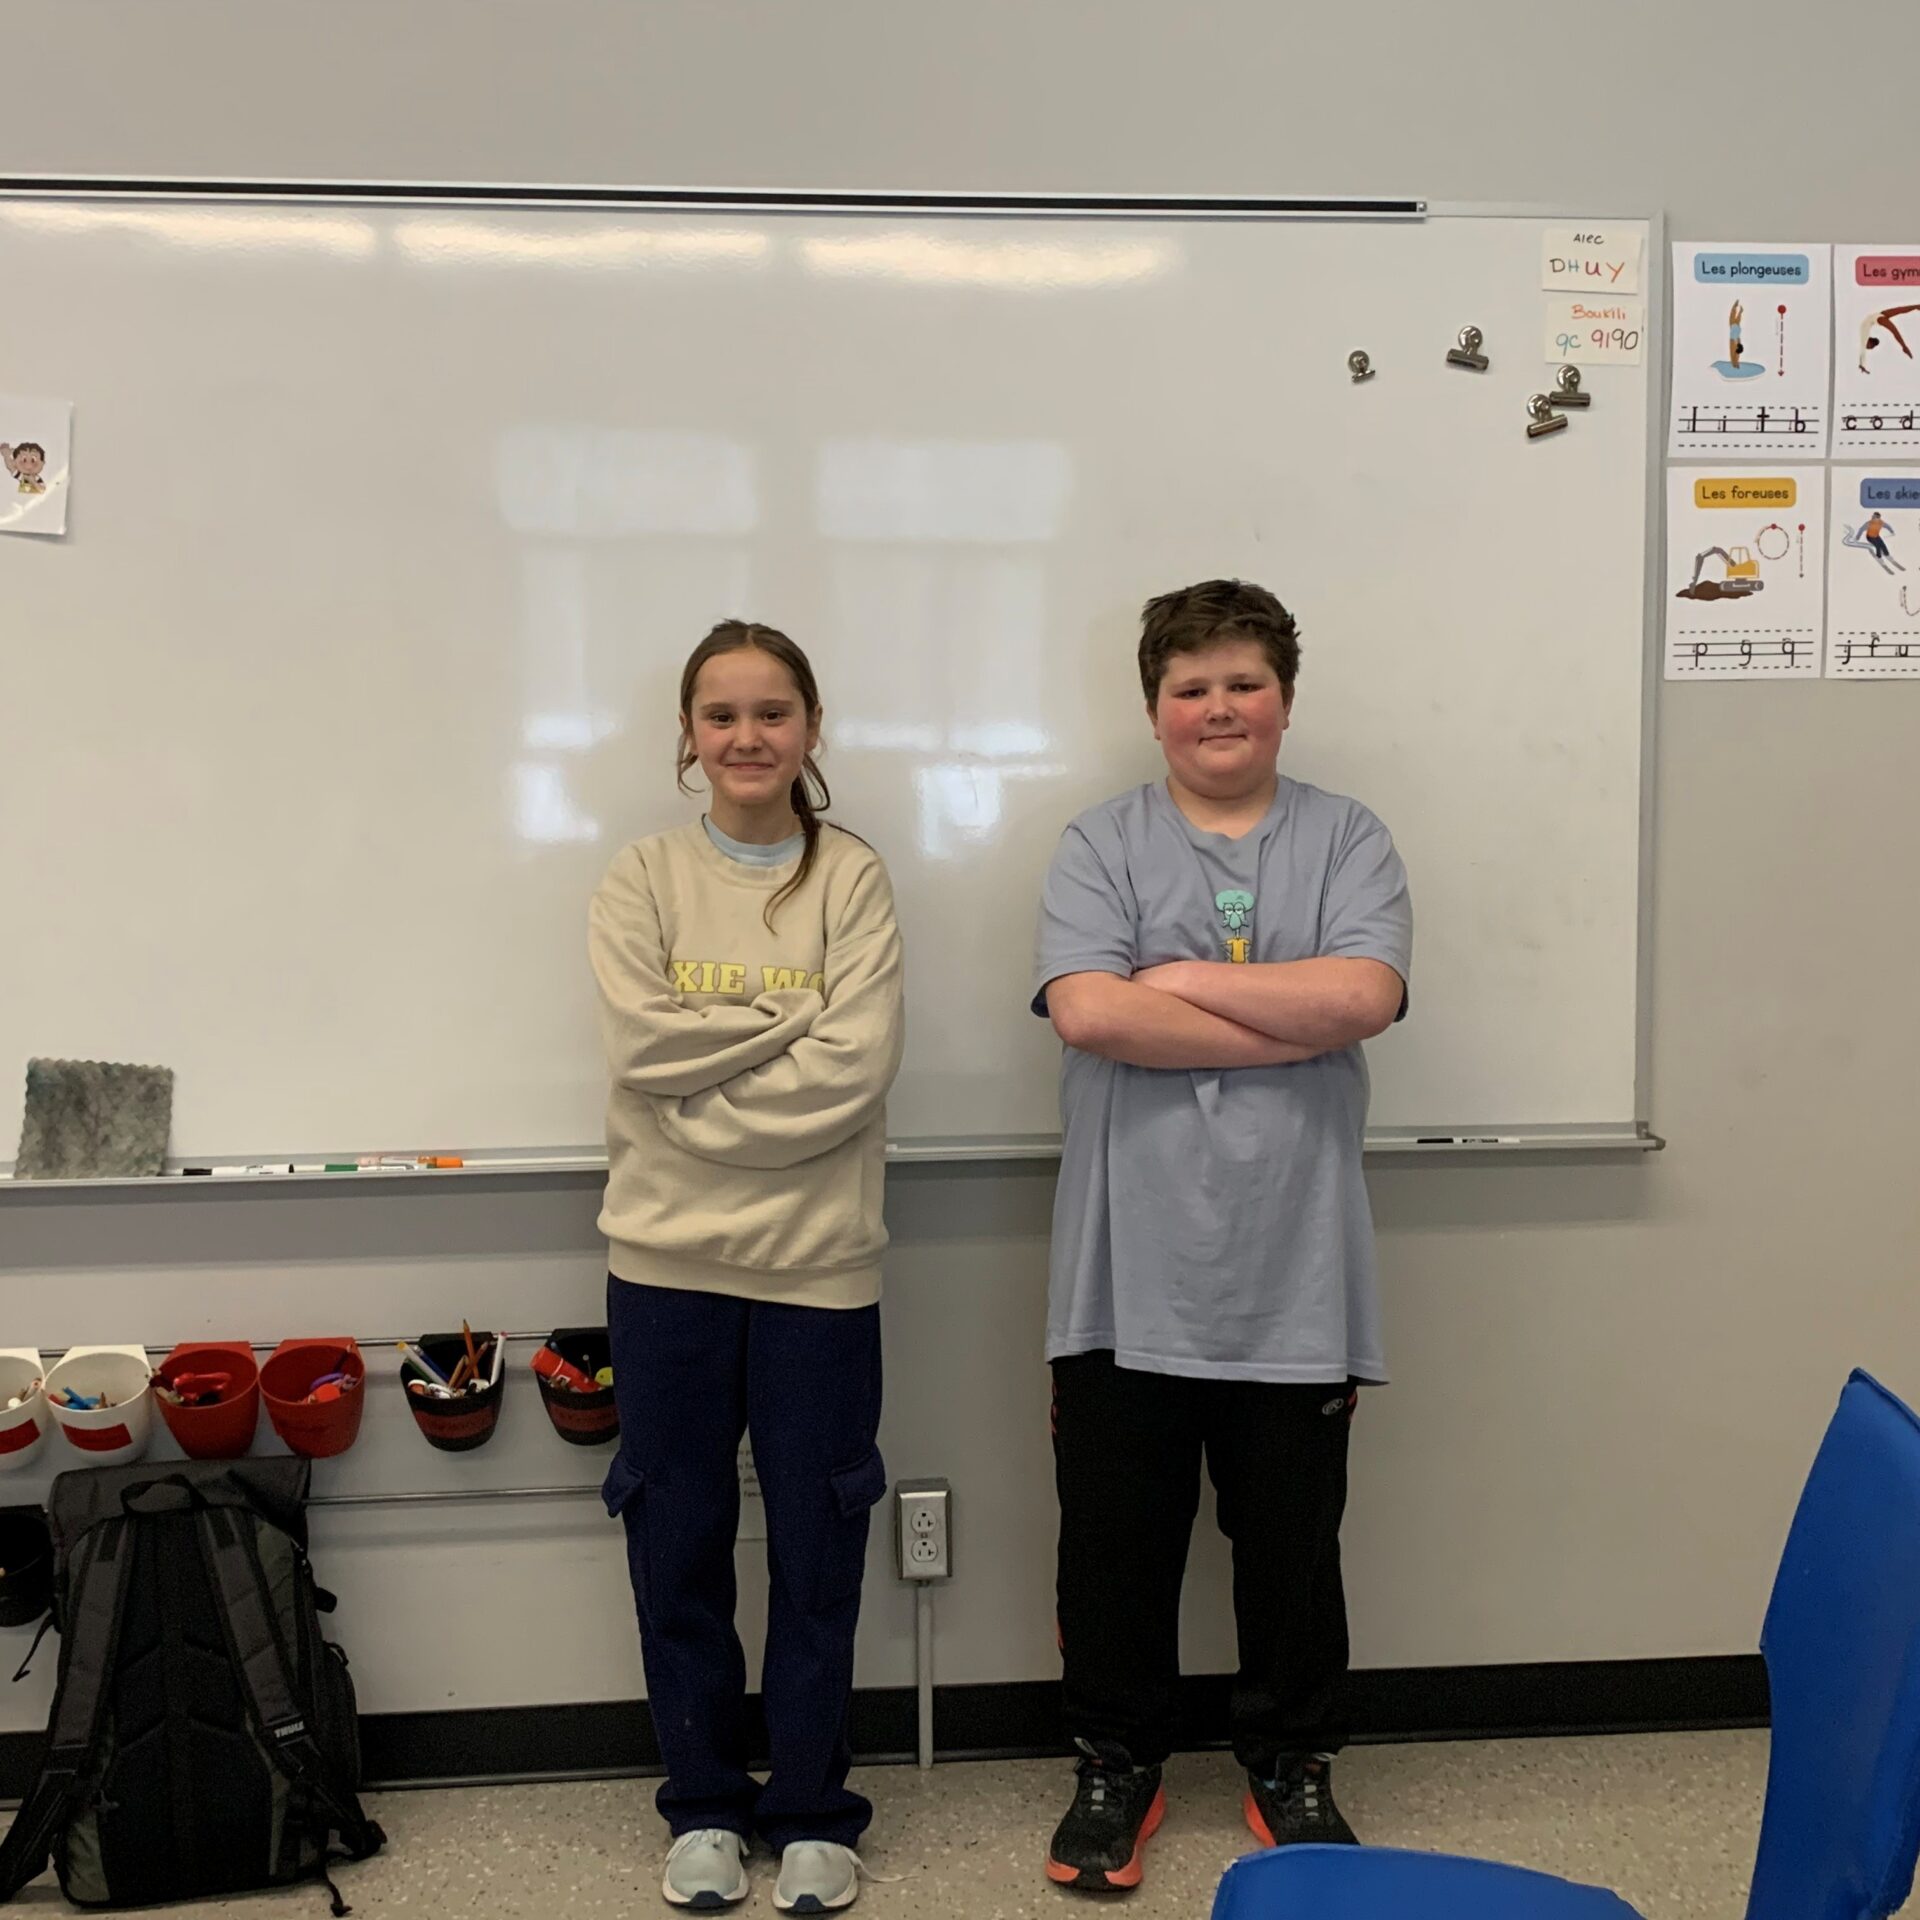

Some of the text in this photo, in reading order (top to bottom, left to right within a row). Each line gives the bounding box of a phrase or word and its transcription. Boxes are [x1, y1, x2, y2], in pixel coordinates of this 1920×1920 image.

[1702, 261, 1802, 278] Les plongeuses
[1863, 263, 1887, 277] Les
[1702, 485, 1789, 499] Les foreuses
[1867, 486, 1890, 499] Les
